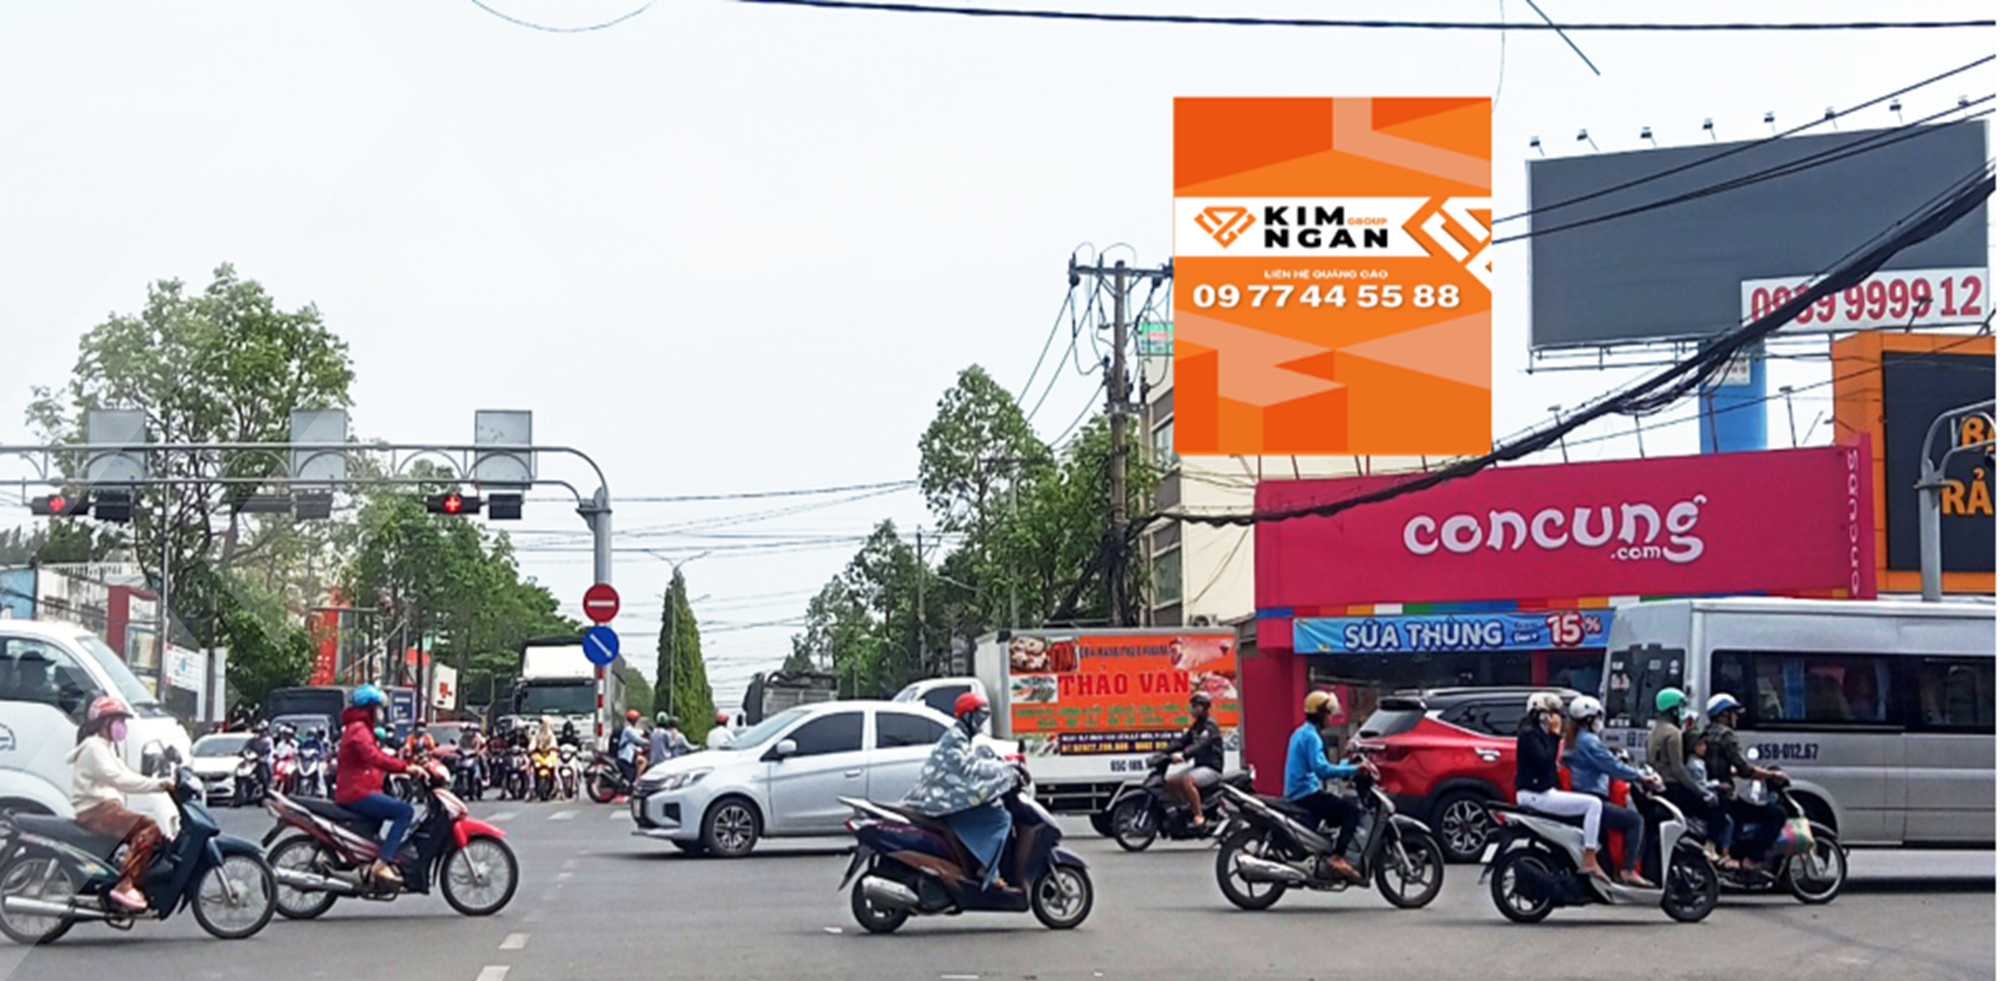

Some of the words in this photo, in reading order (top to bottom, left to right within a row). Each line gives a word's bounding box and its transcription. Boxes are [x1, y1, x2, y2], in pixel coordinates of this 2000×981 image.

[1264, 206, 1345, 226] KIM
[1347, 217, 1388, 226] GROUP
[1264, 228, 1388, 248] NGAN
[1193, 284, 1241, 308] 09
[1248, 285, 1295, 308] 77
[1299, 285, 1347, 308] 44
[1356, 285, 1404, 308] 55
[1412, 284, 1461, 308] 88
[1843, 278, 1933, 322] 9999
[1940, 275, 1983, 317] 12
[1403, 494, 1708, 564] concung
[1610, 545, 1662, 560] .com
